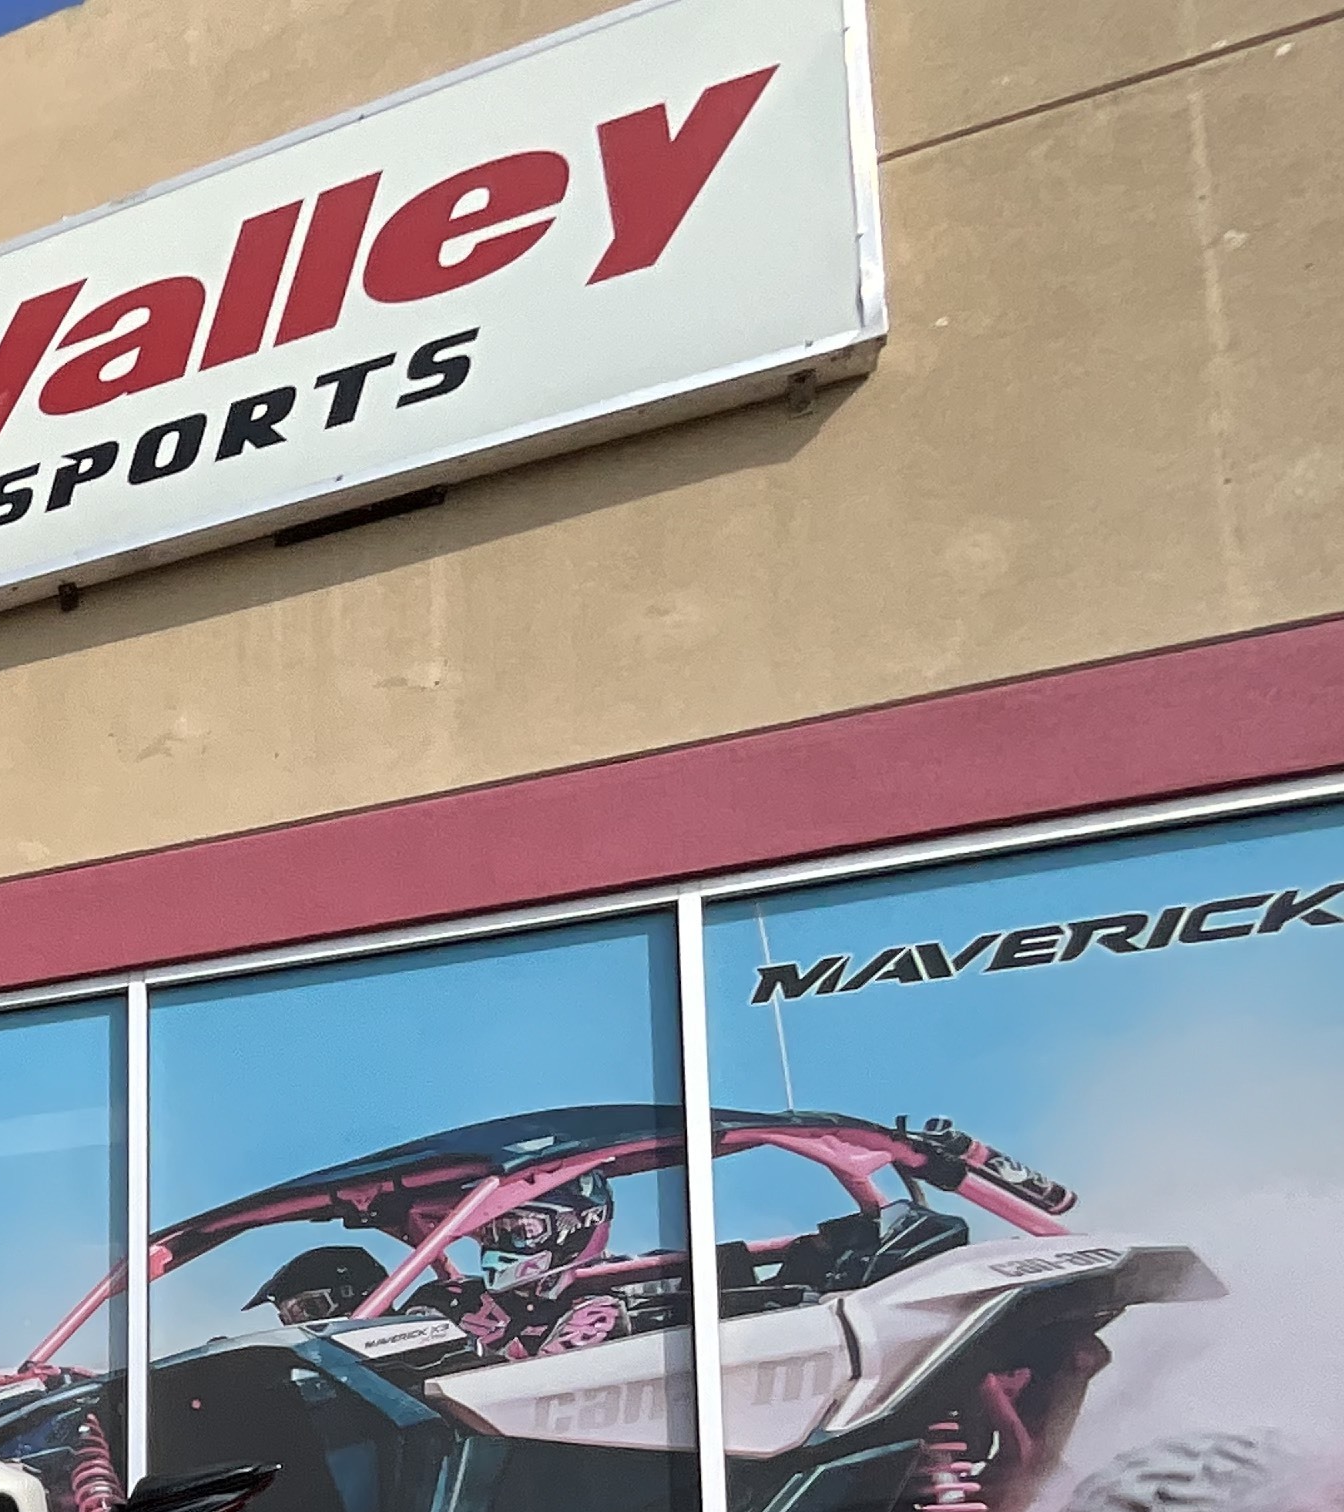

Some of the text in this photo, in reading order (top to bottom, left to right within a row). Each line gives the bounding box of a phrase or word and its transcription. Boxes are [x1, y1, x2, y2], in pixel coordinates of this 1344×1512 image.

[751, 882, 1344, 1005] MAVERICK
[988, 1248, 1123, 1278] can-am
[533, 1352, 835, 1434] canm
